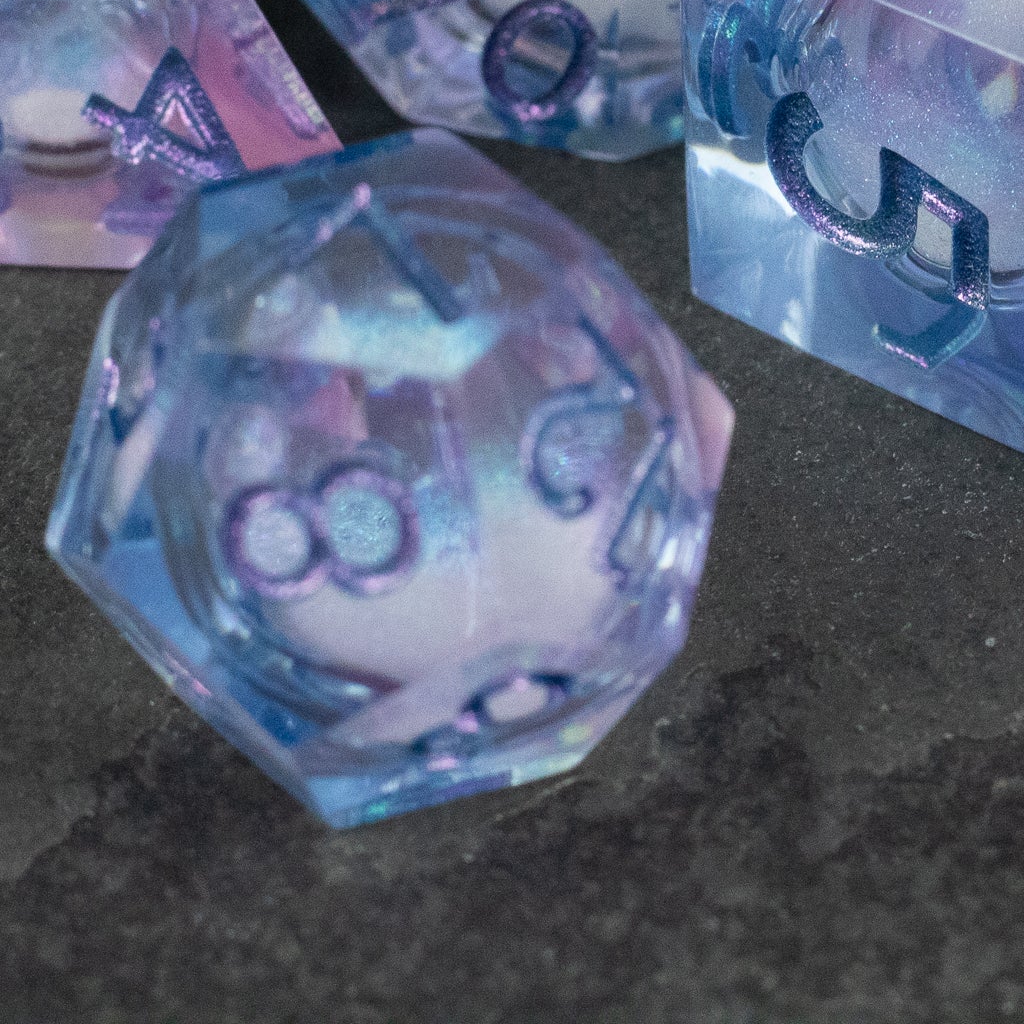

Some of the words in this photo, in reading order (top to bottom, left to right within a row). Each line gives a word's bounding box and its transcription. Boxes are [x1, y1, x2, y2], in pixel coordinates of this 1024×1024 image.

[82, 45, 249, 180] 4
[765, 91, 990, 311] 5
[221, 462, 422, 599] 8
